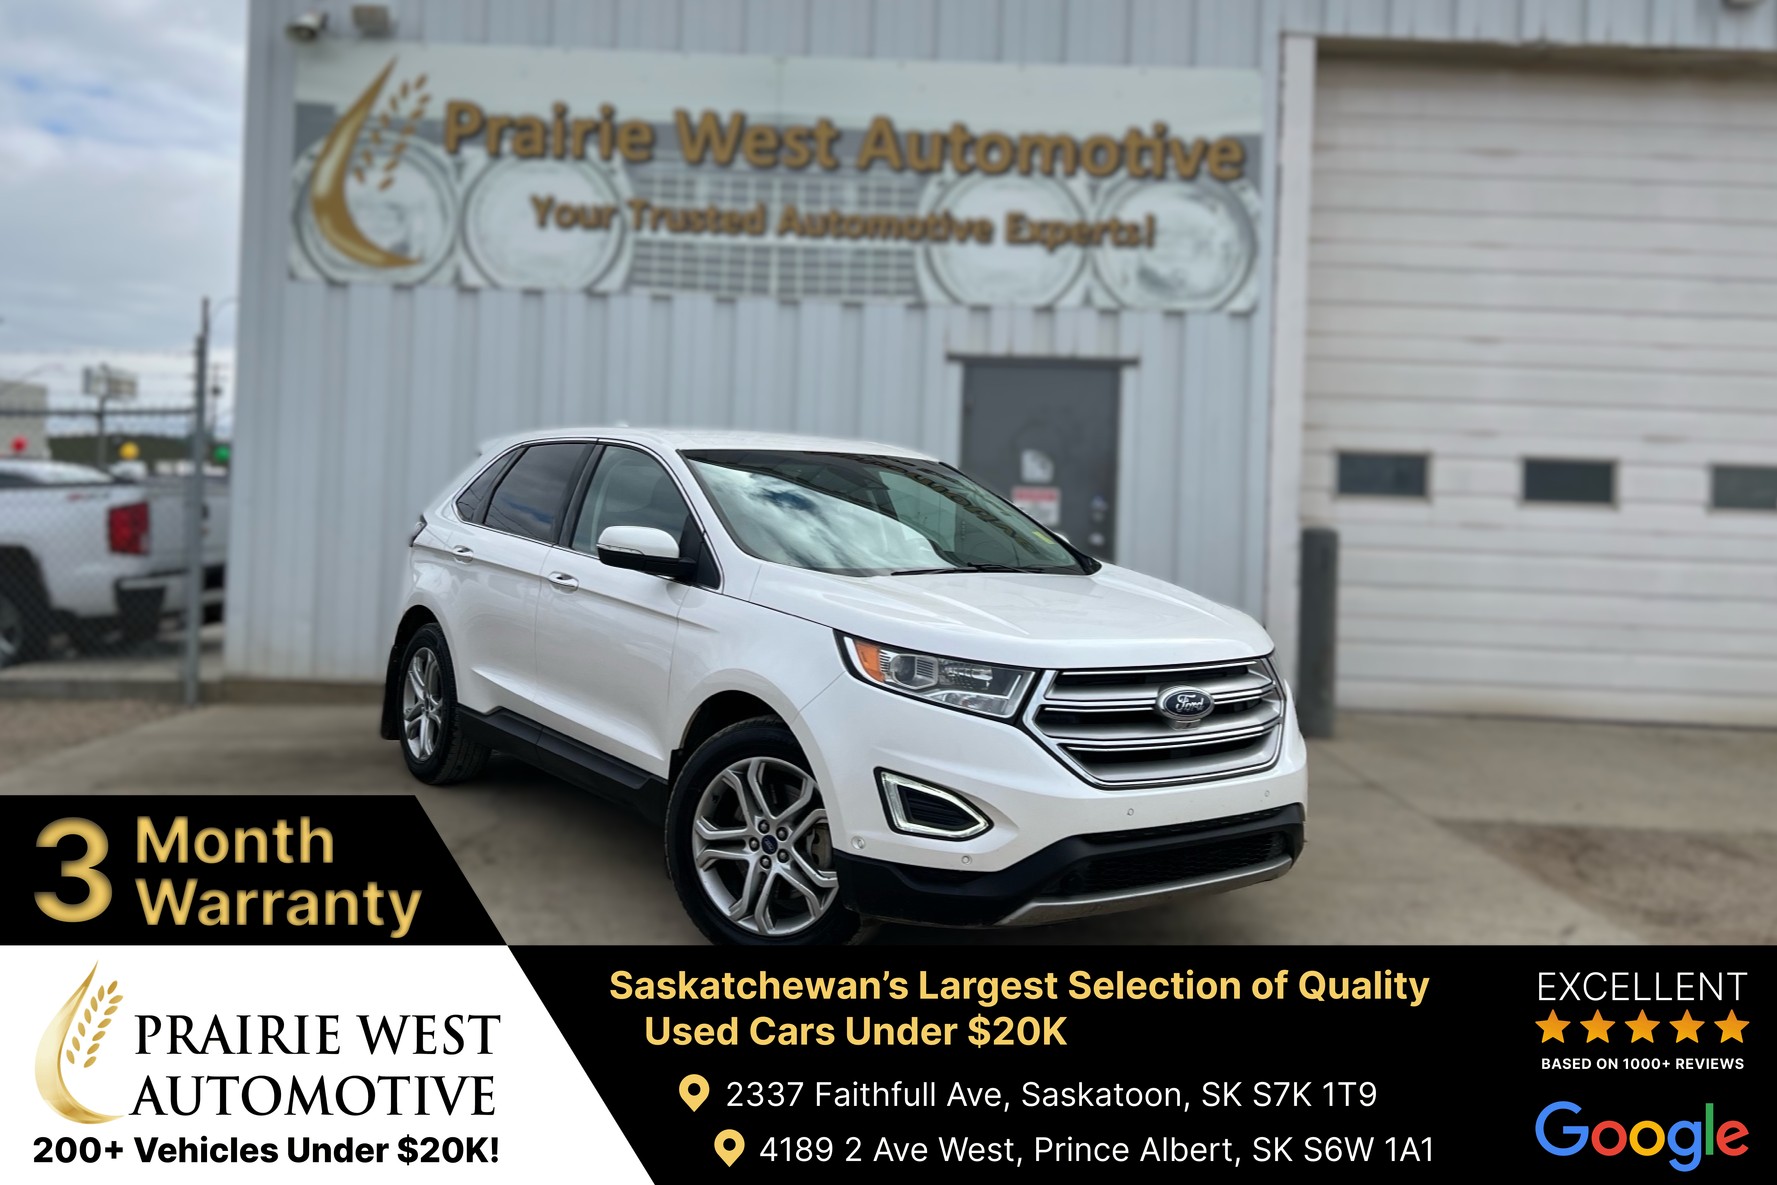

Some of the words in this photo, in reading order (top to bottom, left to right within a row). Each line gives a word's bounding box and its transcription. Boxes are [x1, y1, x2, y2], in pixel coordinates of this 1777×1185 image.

[443, 100, 655, 163] Prairie
[674, 109, 839, 170] West
[857, 116, 1247, 181] Automotive
[530, 194, 617, 231] Your
[627, 199, 766, 236] Trusted
[777, 203, 995, 244] Automotive
[1005, 212, 1156, 252] Experts!
[1174, 693, 1205, 712] Ford
